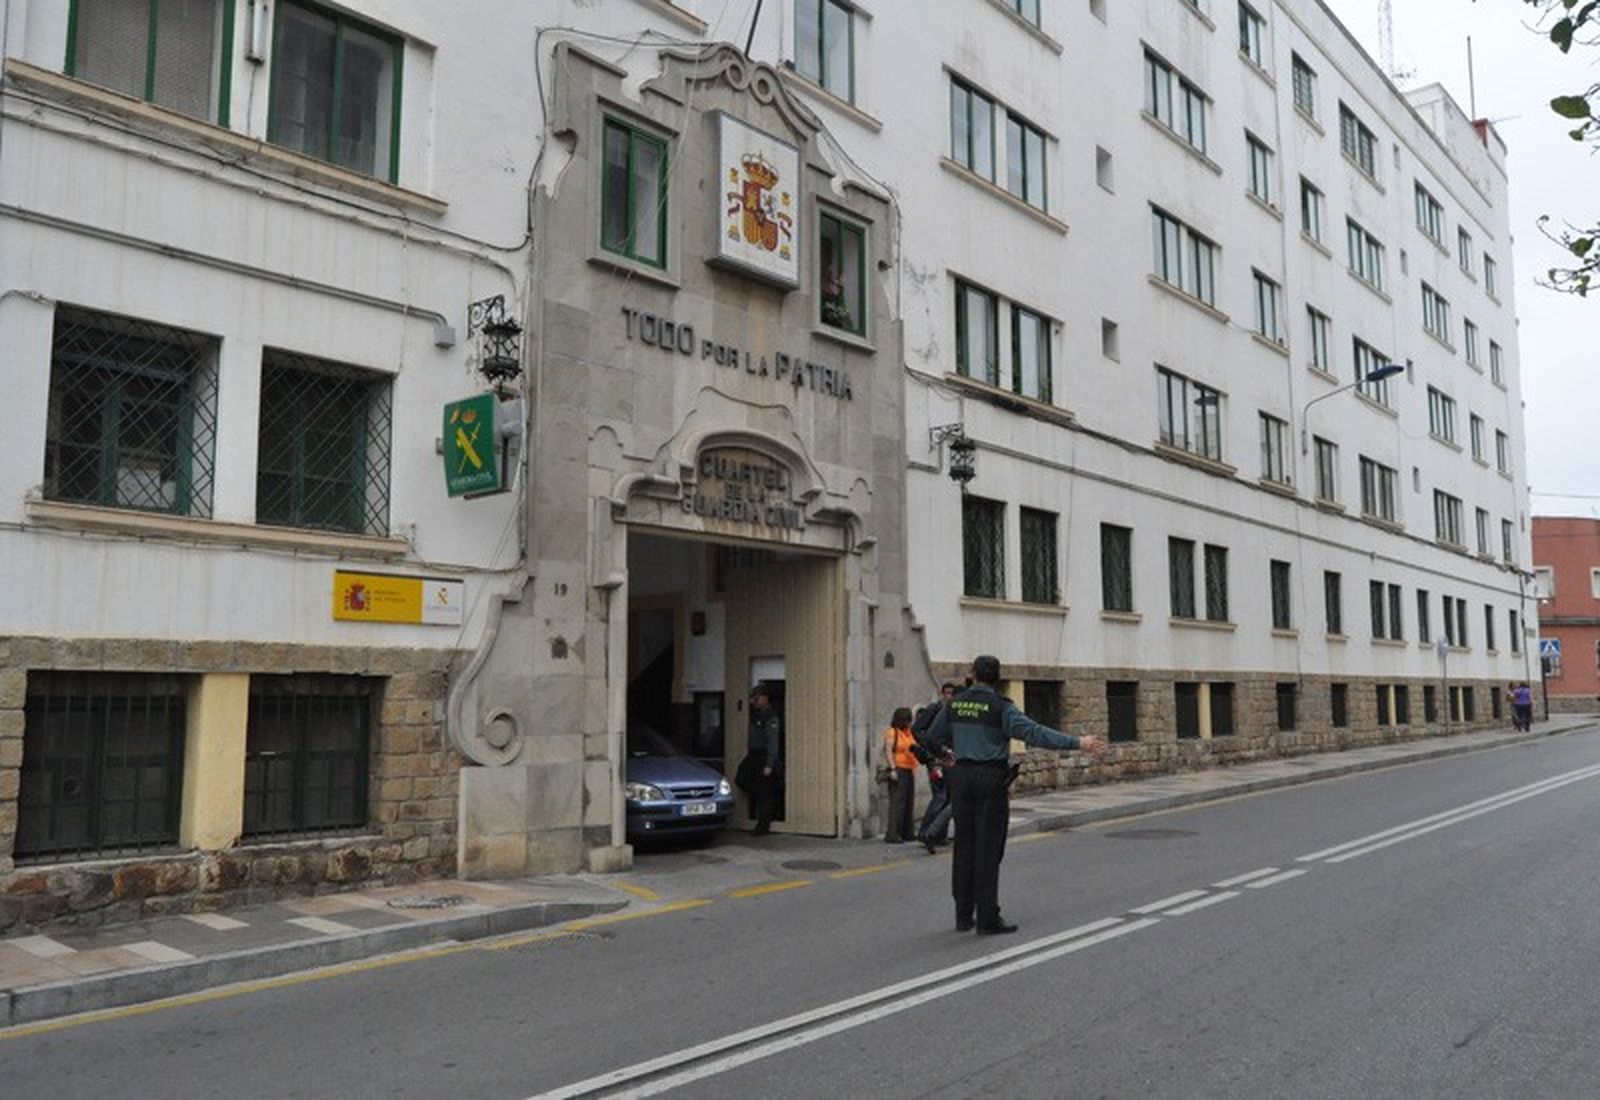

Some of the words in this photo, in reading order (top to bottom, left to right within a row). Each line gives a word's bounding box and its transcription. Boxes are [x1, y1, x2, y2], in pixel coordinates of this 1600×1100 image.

[621, 307, 695, 355] TODO
[701, 339, 738, 368] POR
[745, 351, 768, 377] LA
[775, 351, 853, 400] PATRIA
[700, 457, 786, 492] CUARTEL
[681, 494, 761, 523] GUARDIA
[554, 583, 567, 596] 19
[951, 702, 989, 712] GUARDIA
[957, 710, 979, 718] CIVIL
